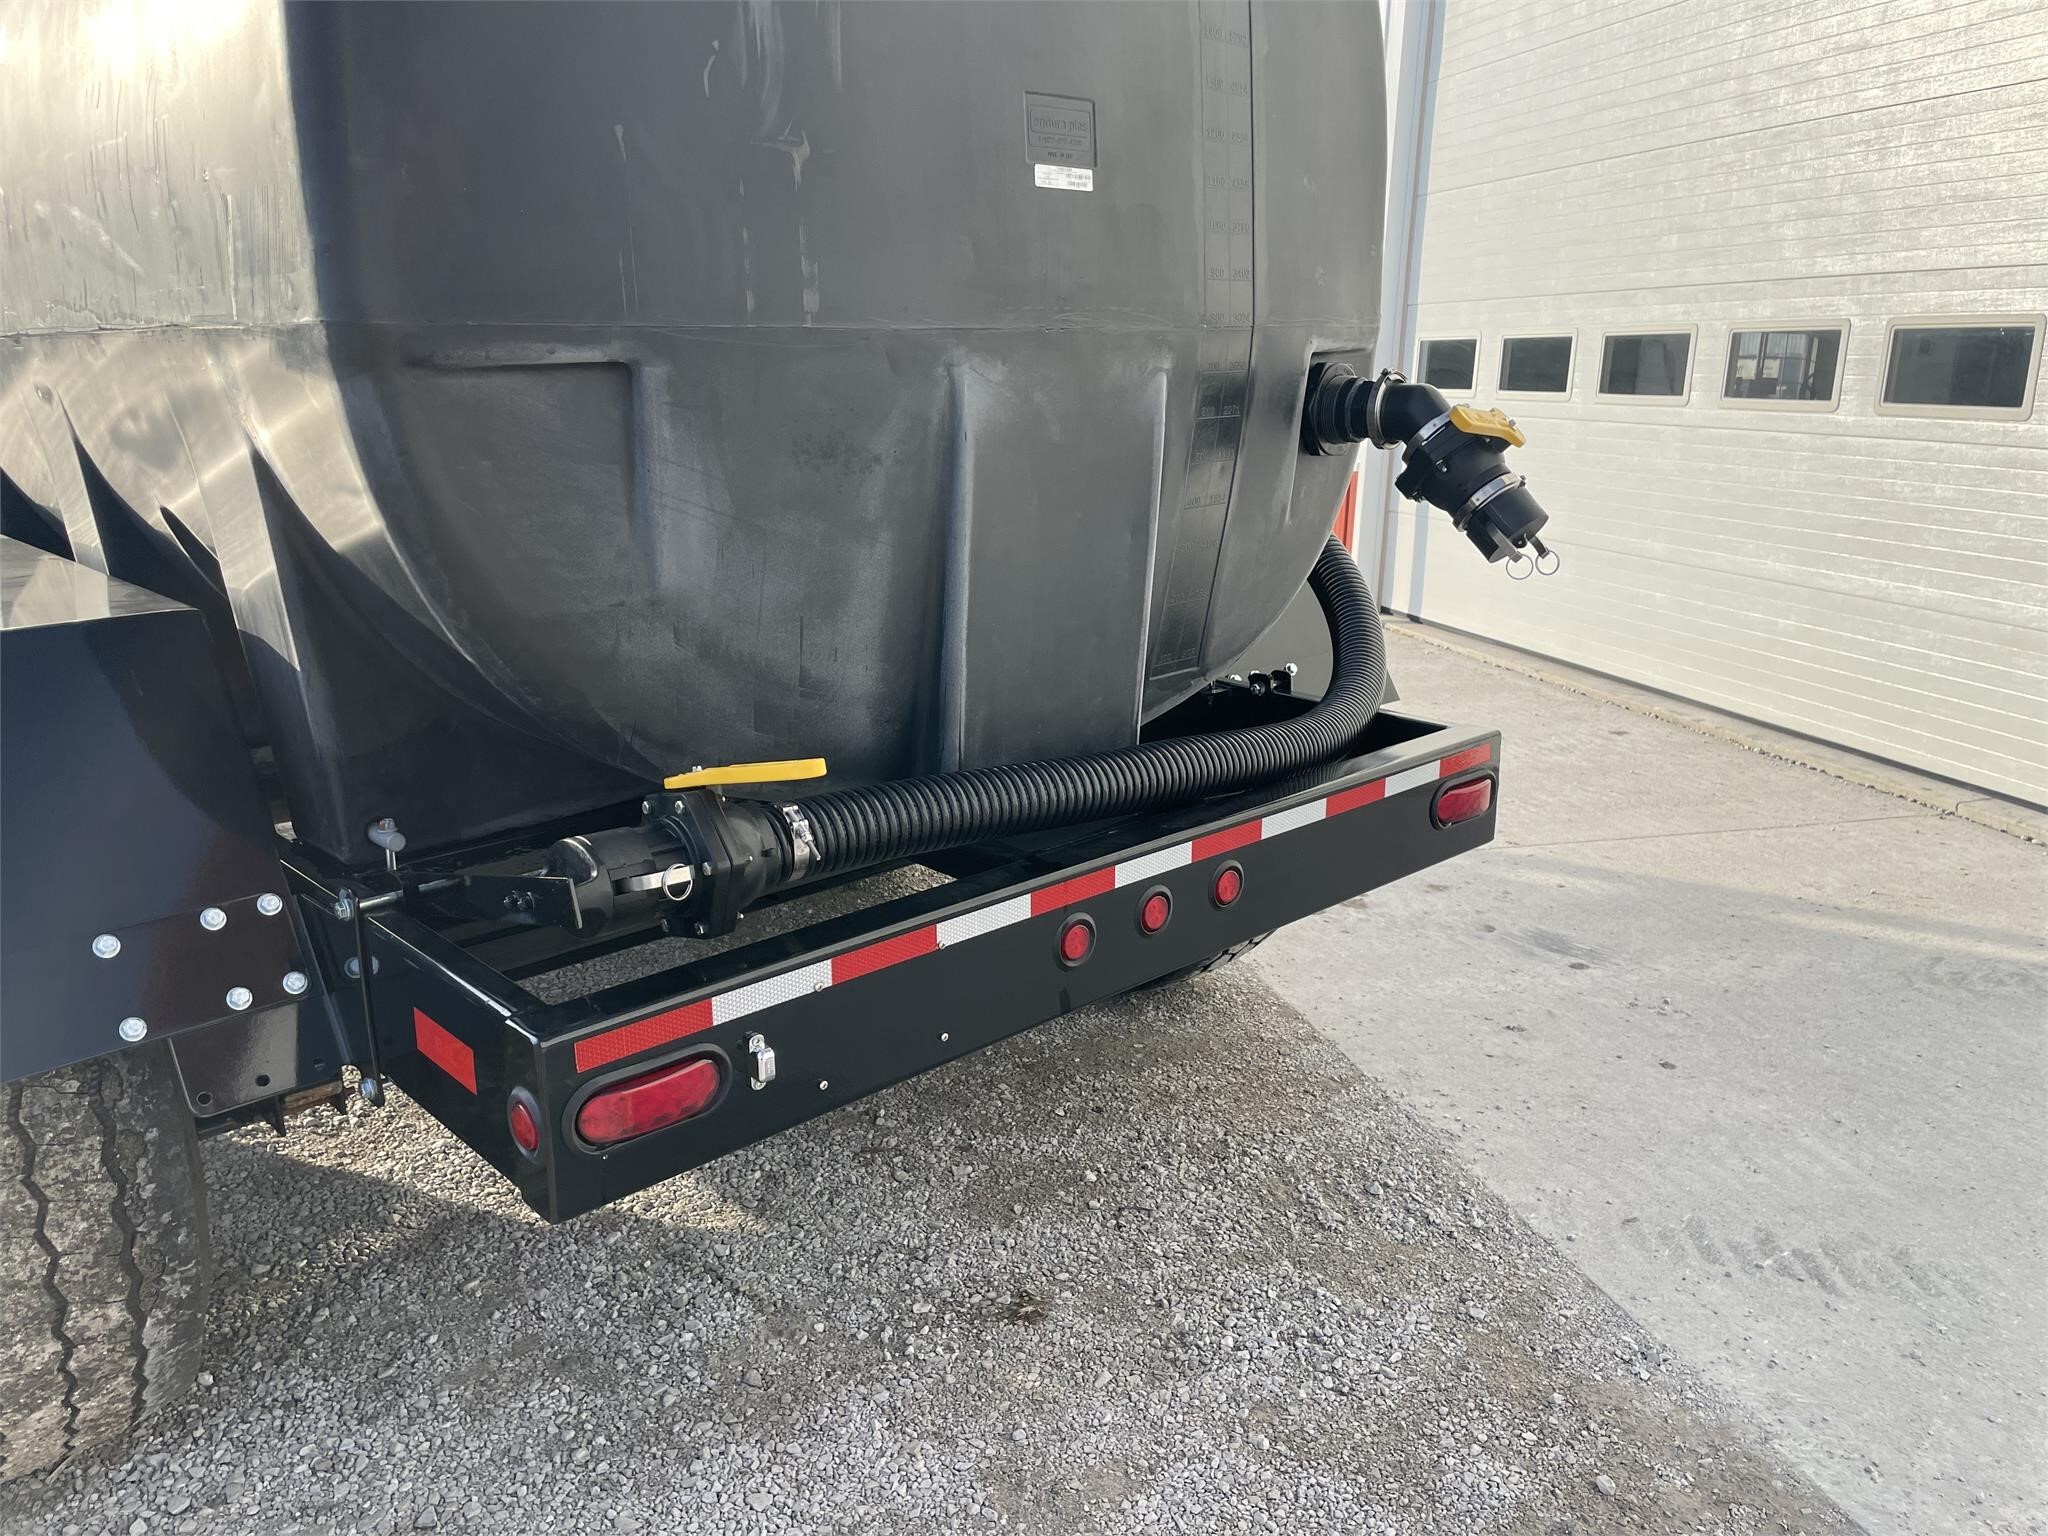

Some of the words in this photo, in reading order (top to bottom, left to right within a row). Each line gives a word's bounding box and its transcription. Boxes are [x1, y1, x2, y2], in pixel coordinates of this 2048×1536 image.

[1069, 119, 1088, 134] plas
[1200, 406, 1215, 417] 600
[1223, 404, 1240, 415] 2271
